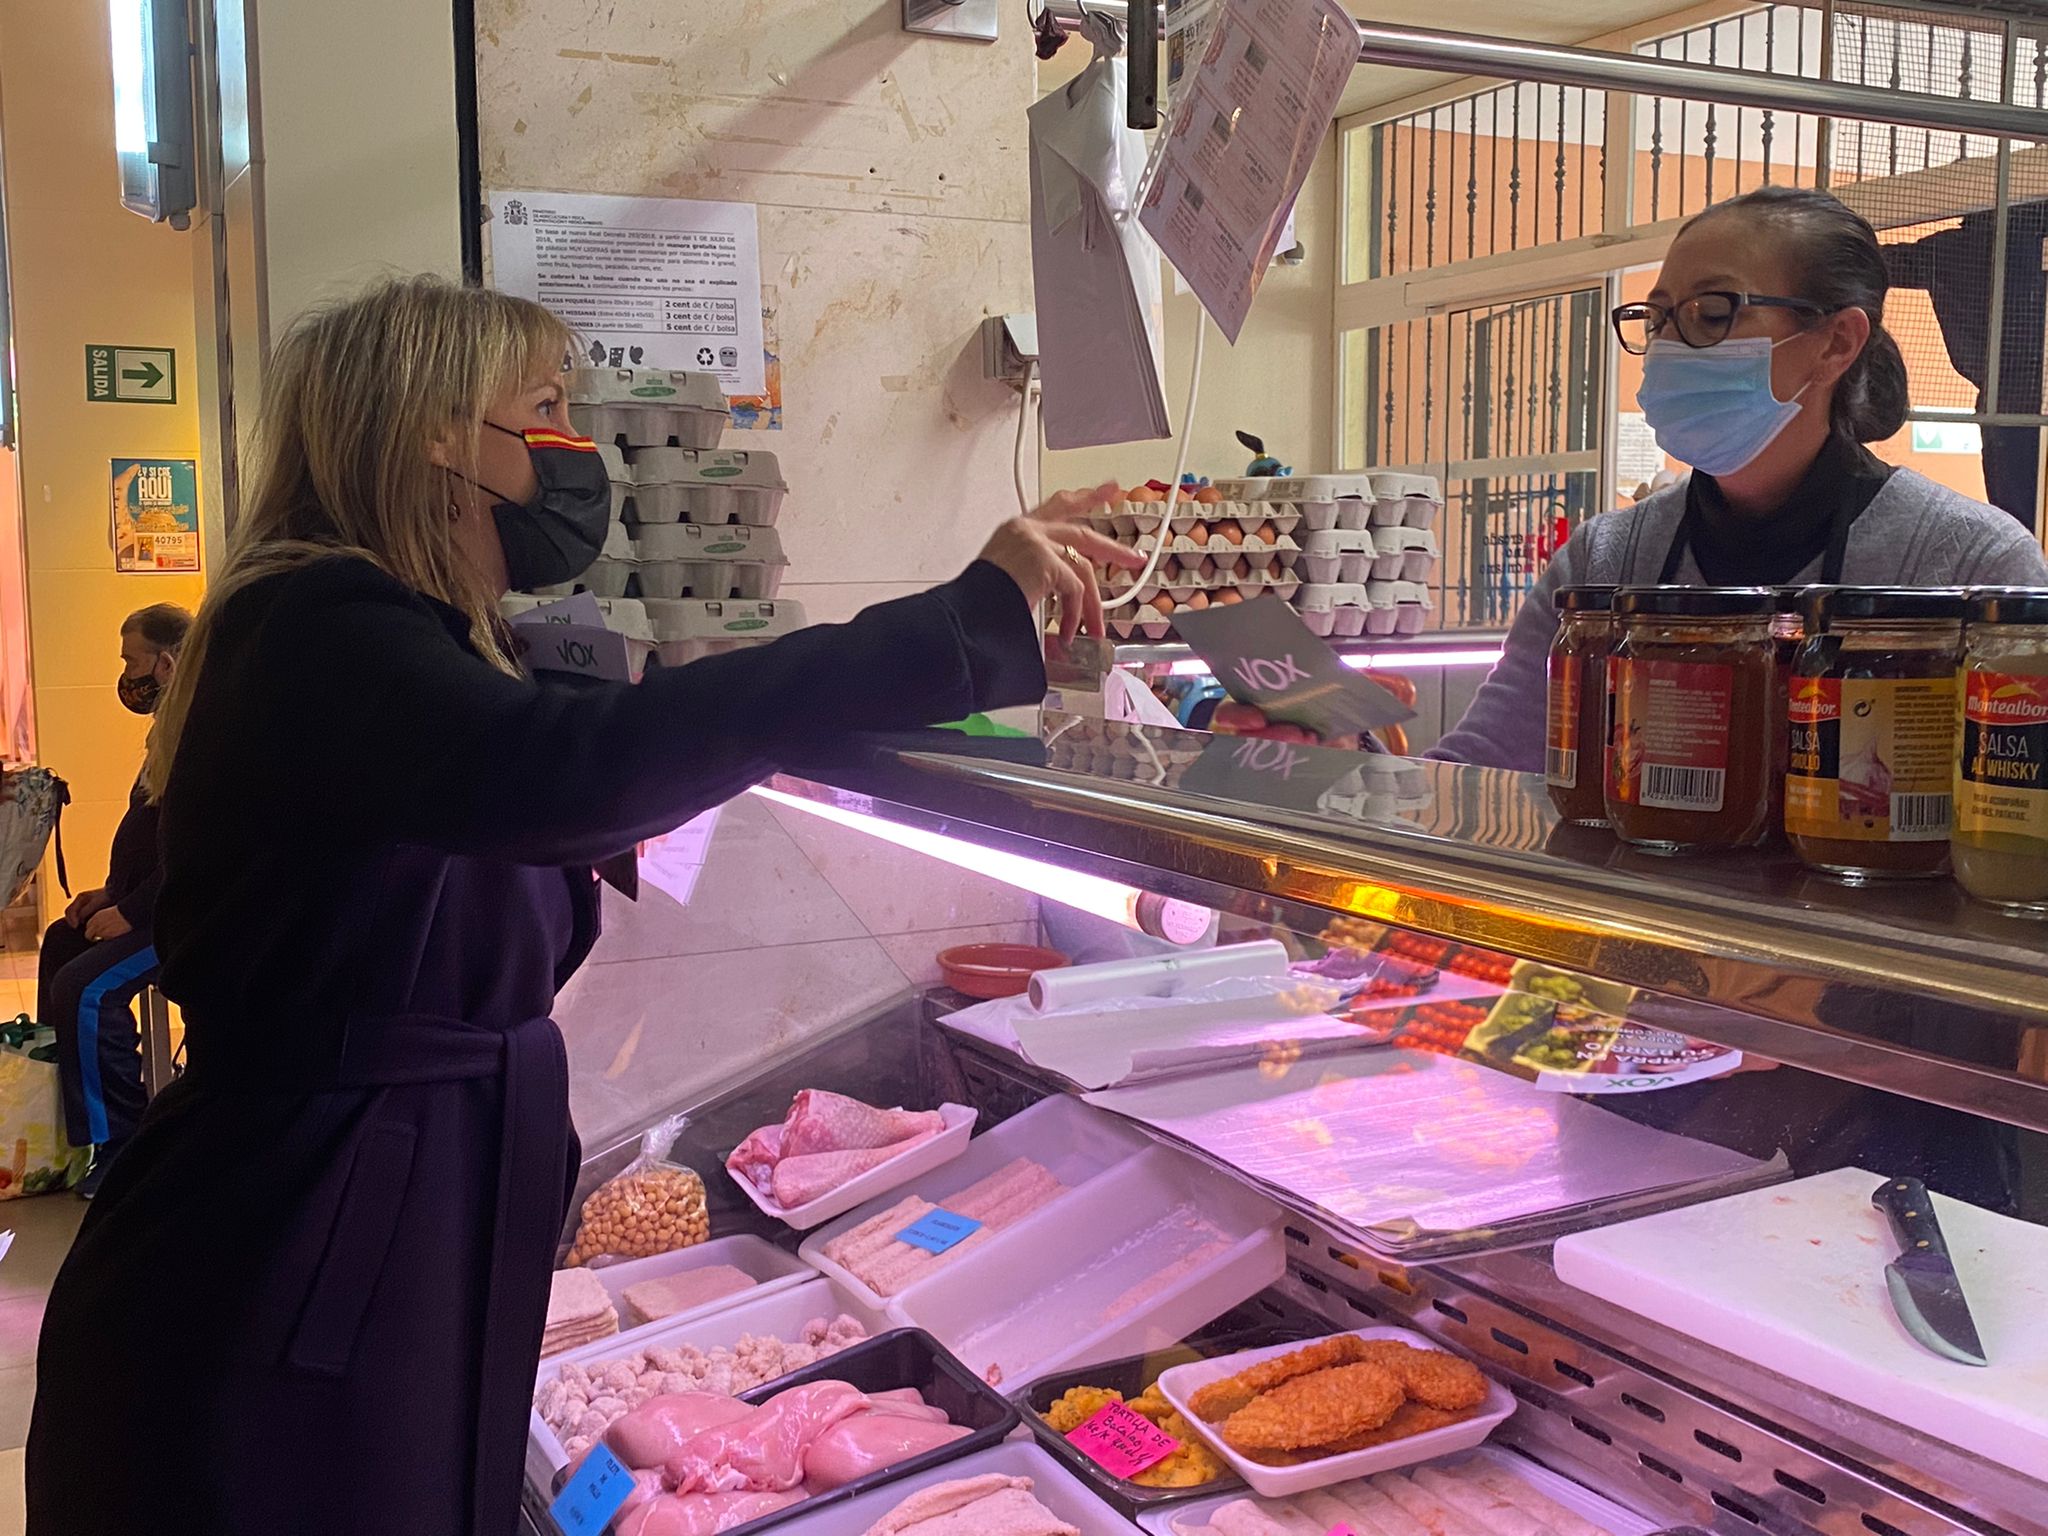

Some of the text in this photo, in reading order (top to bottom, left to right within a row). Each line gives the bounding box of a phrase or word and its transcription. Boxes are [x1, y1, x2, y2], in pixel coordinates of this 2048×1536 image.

[716, 302, 734, 310] bolsa
[717, 324, 735, 332] bolsa
[92, 349, 109, 397] SALIDA
[149, 467, 157, 476] SI
[155, 536, 182, 544] 40795
[556, 638, 598, 668] VOX
[1232, 653, 1312, 691] VOX
[1968, 695, 2048, 717] Montealbor
[1791, 729, 1821, 751] SALSA
[1978, 731, 2029, 758] SALSA
[1971, 757, 2041, 781] AL WHISKY
[1584, 1042, 1674, 1056] BARRIO
[1615, 1053, 1714, 1064] COMPRA
[1606, 1077, 1675, 1088] VOX
[1109, 1402, 1149, 1433] TORTILLA
[1151, 1434, 1171, 1447] DE
